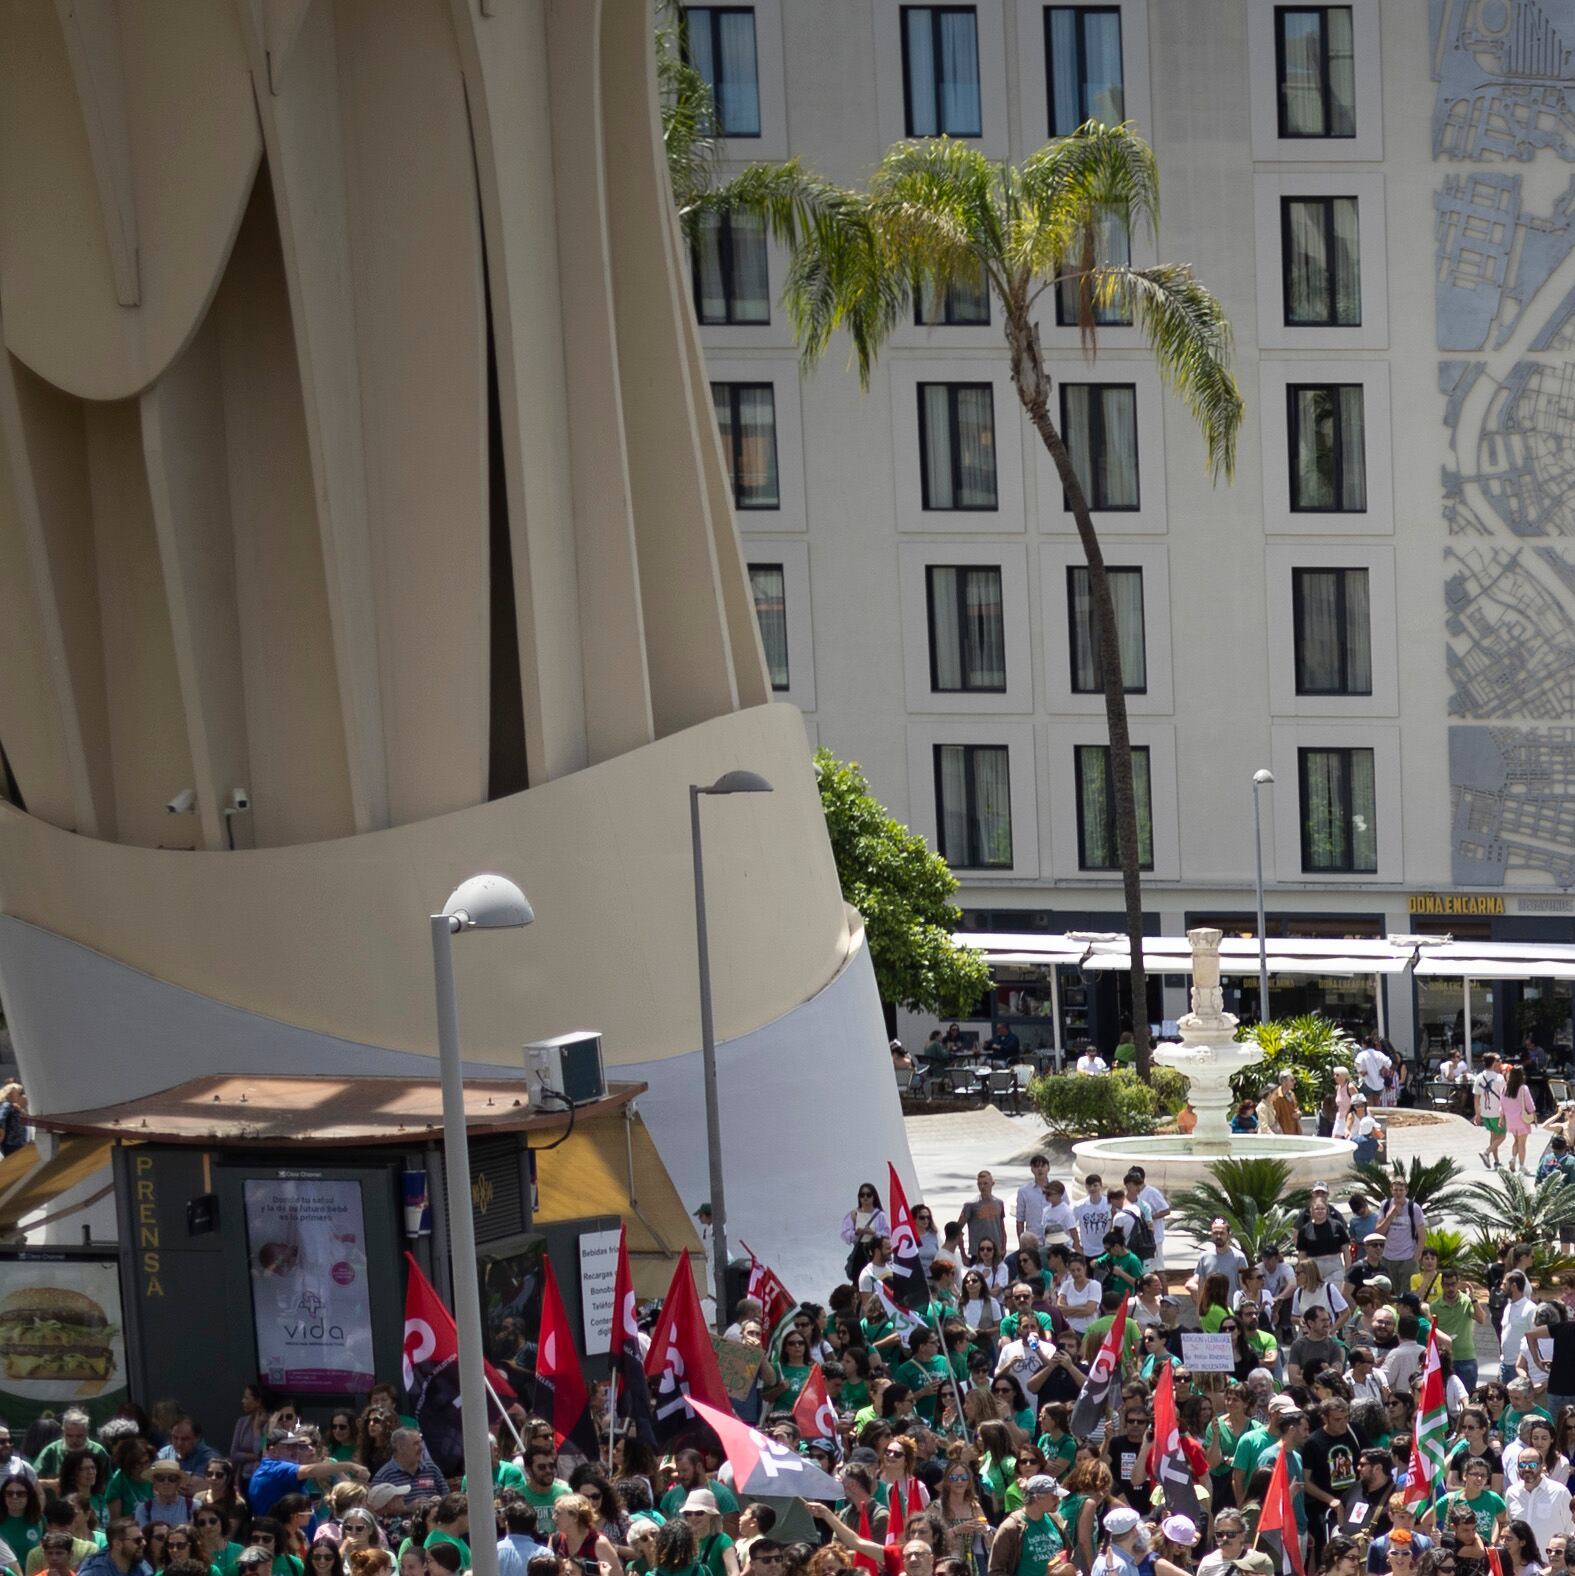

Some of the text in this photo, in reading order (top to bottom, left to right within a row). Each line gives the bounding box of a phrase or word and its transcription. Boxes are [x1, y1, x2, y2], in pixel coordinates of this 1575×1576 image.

[1408, 892, 1505, 913] DOÑA ENCARNA
[136, 1157, 164, 1297] PRENSA
[582, 1248, 607, 1258] Bebidas
[584, 1271, 613, 1281] Recargas
[284, 1317, 344, 1340] vida
